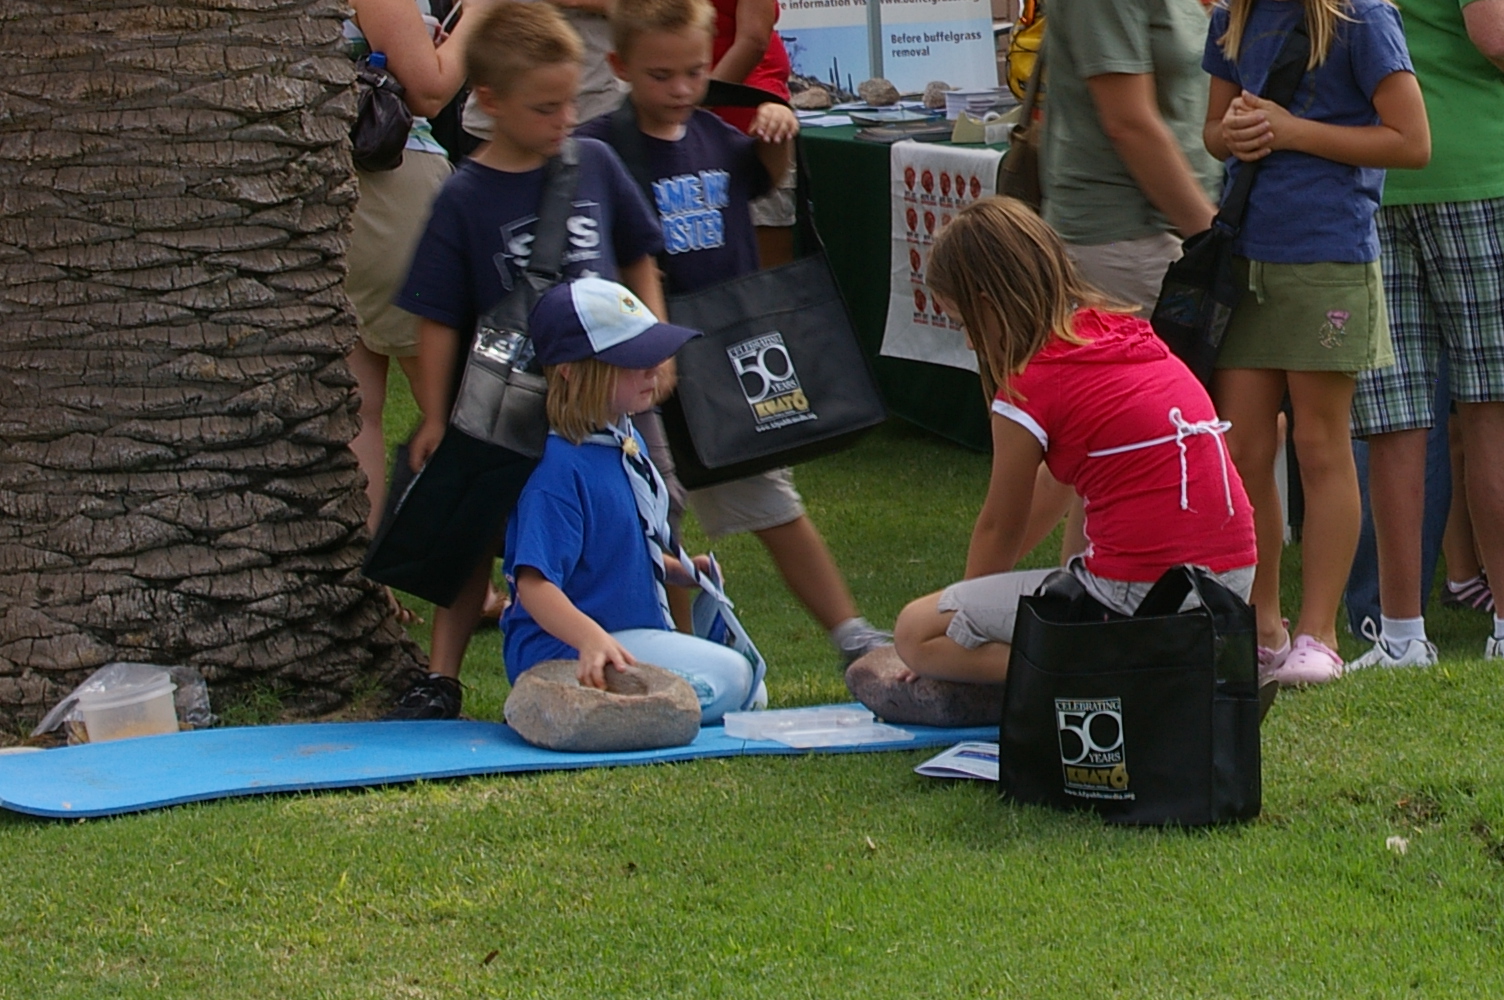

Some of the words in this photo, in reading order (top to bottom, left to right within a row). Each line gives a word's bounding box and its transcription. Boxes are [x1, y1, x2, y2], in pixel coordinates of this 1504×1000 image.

[891, 33, 922, 45] Before
[923, 30, 982, 44] buffelgrass
[892, 46, 930, 58] removal
[733, 344, 794, 405] 50
[1056, 701, 1120, 711] CELEBRATING
[1059, 710, 1124, 765] 50
[1089, 752, 1122, 763] YEARS
